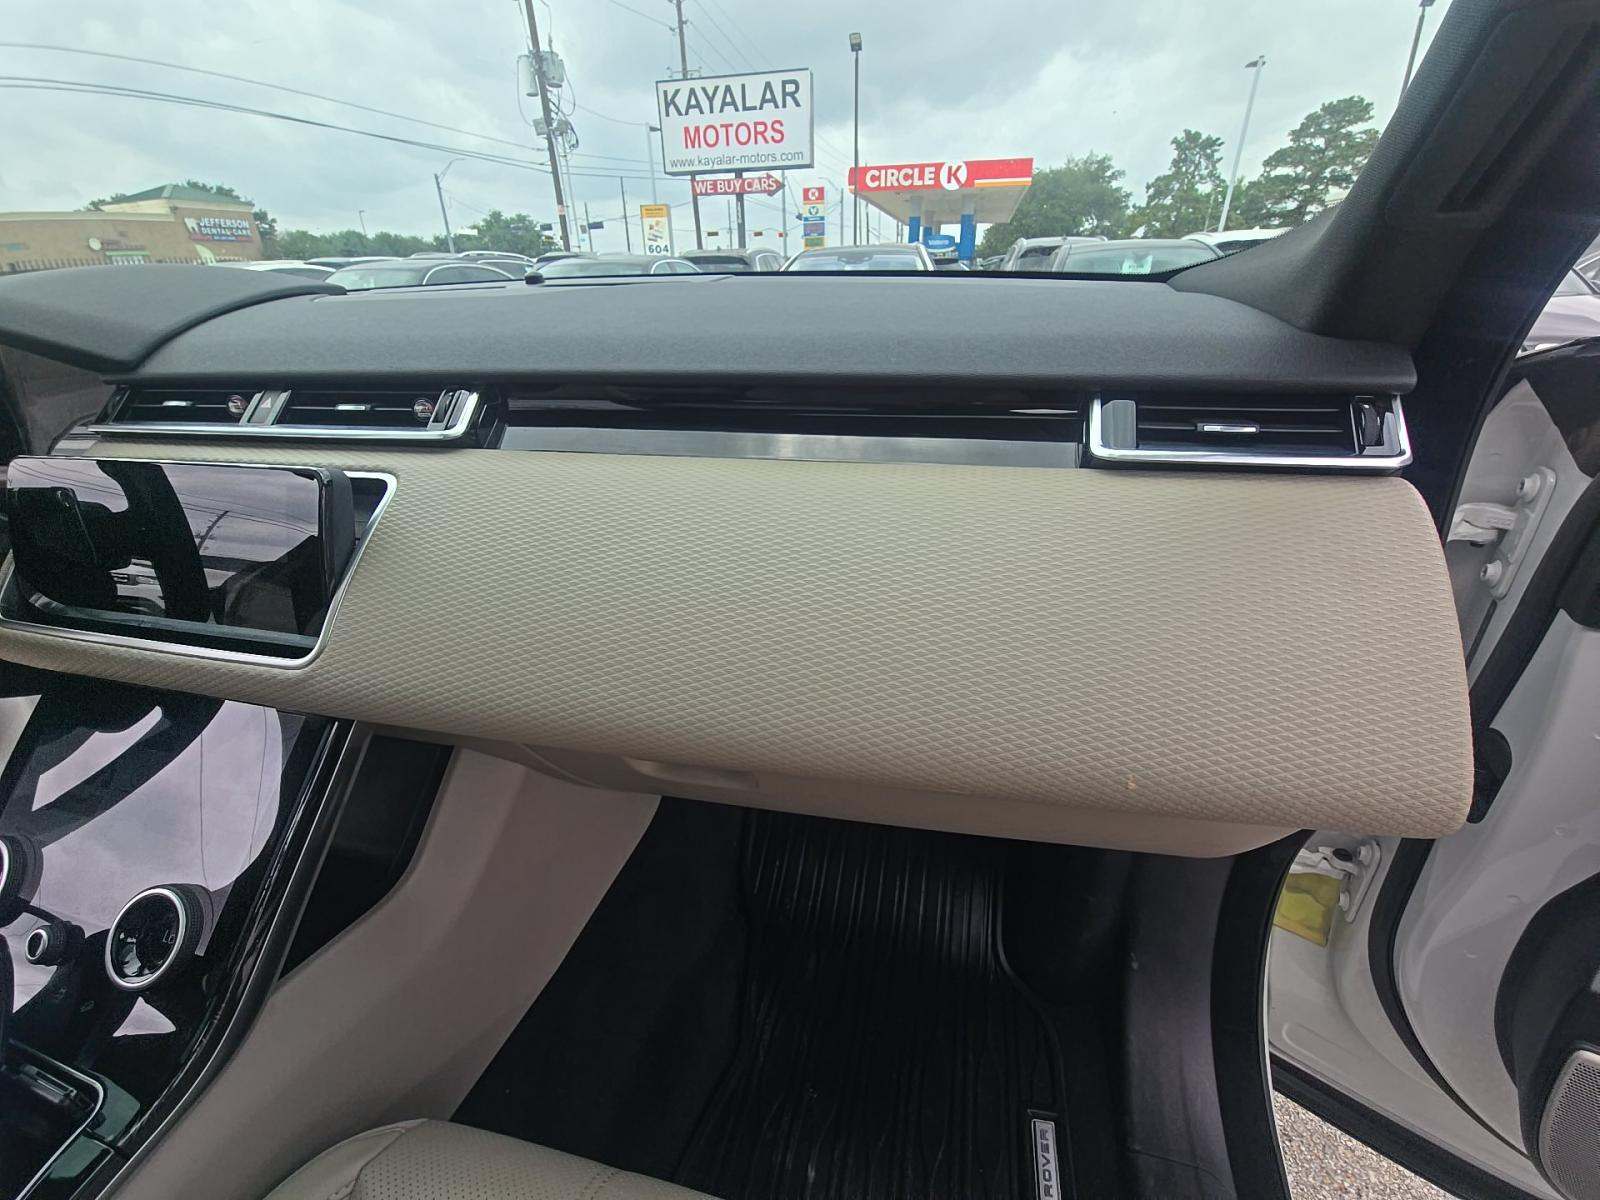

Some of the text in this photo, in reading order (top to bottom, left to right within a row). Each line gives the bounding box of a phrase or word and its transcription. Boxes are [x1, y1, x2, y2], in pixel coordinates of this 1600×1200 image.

[662, 78, 801, 117] KAYALAR
[683, 119, 785, 149] MOTORS
[670, 151, 804, 169] www.kayalar-motors.com
[693, 178, 777, 194] WE BUY CARS
[865, 165, 963, 188] CIRCLE K
[200, 217, 250, 229] JEFFERSON
[1039, 1128, 1054, 1198] ROVER
